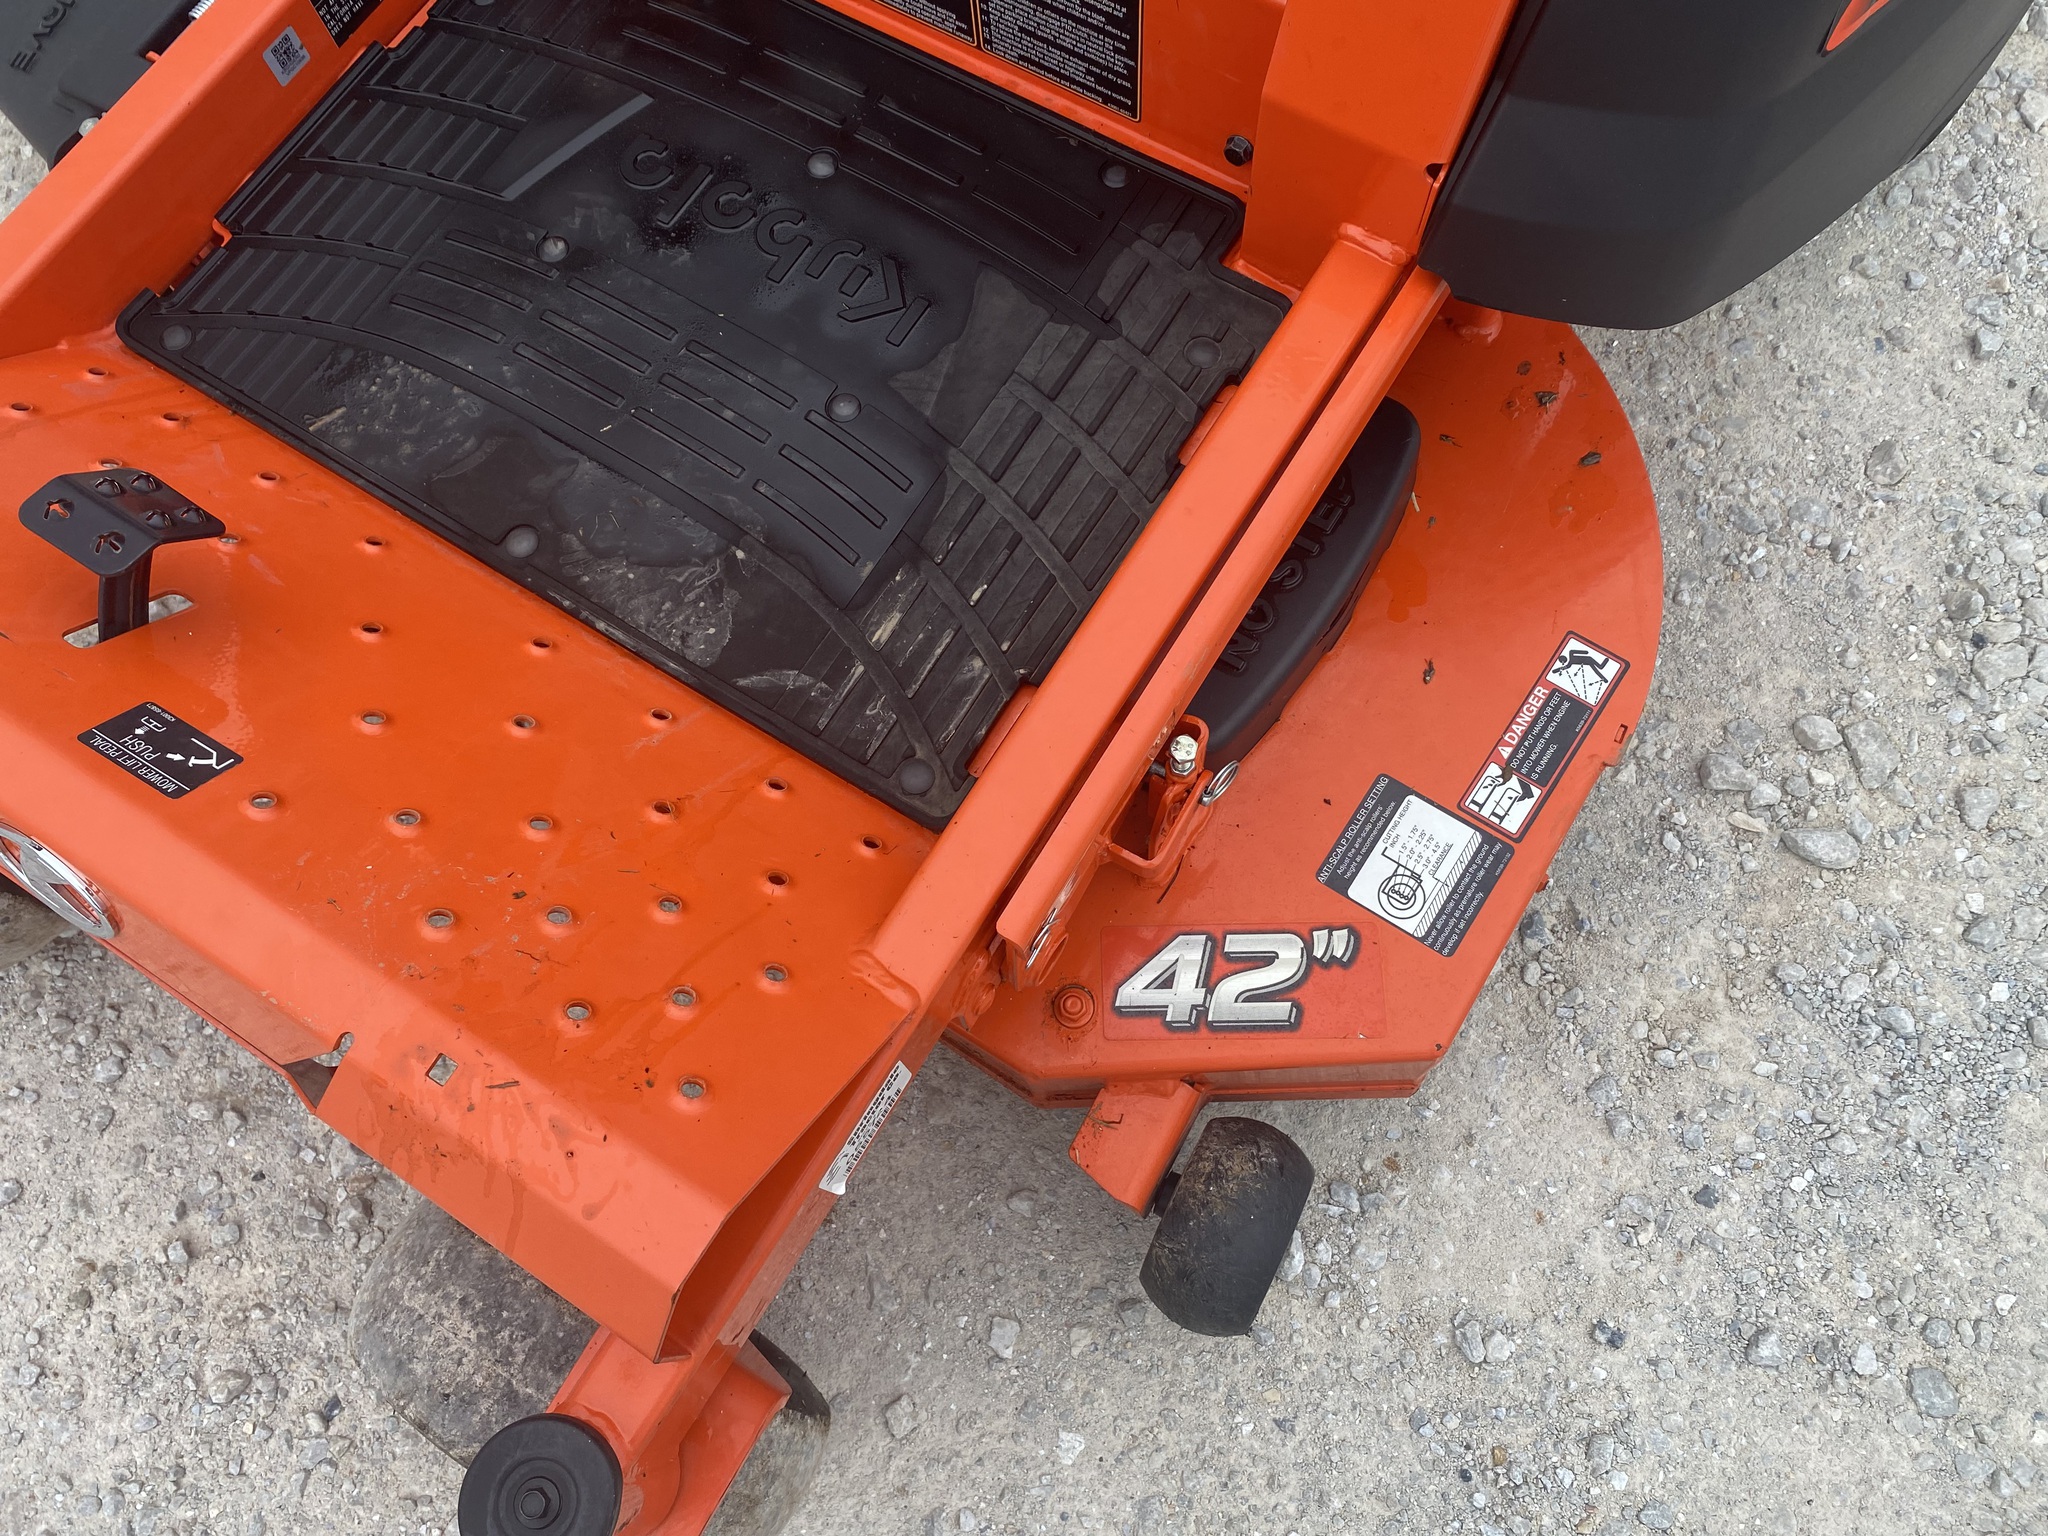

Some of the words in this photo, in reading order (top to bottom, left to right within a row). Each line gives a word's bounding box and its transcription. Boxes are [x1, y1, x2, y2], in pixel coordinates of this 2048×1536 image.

[322, 12, 331, 22] IN
[330, 2, 340, 14] THE
[326, 0, 354, 29] CALIFORNIA
[330, 21, 343, 36] DOES
[342, 10, 352, 23] NOT
[619, 133, 932, 348] Kubota
[1503, 684, 1549, 745] DANGER
[1509, 757, 1520, 768] DO
[1515, 745, 1528, 759] NOT
[1523, 733, 1535, 747] PUT
[1530, 714, 1547, 735] HANDS
[1542, 705, 1553, 716] OR
[1548, 691, 1562, 707] FEET
[1519, 758, 1533, 774] INTO
[1528, 737, 1547, 761] MOWER
[1542, 720, 1557, 739] WHEN
[1552, 699, 1571, 722] ENGINE
[90, 735, 119, 757] PEDAL
[117, 754, 142, 770] LIFT
[119, 735, 161, 760] PUSH
[1529, 771, 1539, 780] IS
[1534, 741, 1558, 773] RUNNING.
[137, 765, 179, 793] MOWER
[1317, 837, 1349, 883] ANTI-SCALP
[1344, 807, 1367, 839] ROLLER
[1363, 775, 1388, 809] SETTING
[1343, 861, 1358, 880] height
[1354, 854, 1362, 862] as
[1358, 816, 1386, 855] recommended
[1381, 799, 1396, 818] below.
[1381, 819, 1400, 844] CUTTING
[1396, 798, 1413, 820] HEIGHT
[1388, 833, 1401, 848] INCH
[1335, 856, 1351, 875] Adjust
[1346, 847, 1356, 858] the
[1352, 821, 1373, 849] anti-scalp
[1426, 841, 1452, 876] CLEARANCE
[1423, 927, 1438, 946] Never
[1433, 913, 1447, 929] allow
[1442, 899, 1455, 914] roller
[1451, 892, 1459, 900] to
[1455, 872, 1472, 894] contact
[1467, 862, 1477, 873] the
[1472, 843, 1490, 864] ground
[1431, 916, 1458, 952] continuously
[1453, 909, 1461, 917] as
[1457, 881, 1479, 910] premature
[1473, 867, 1486, 882] roller
[1482, 853, 1495, 868] wear
[1491, 841, 1503, 855] may
[1439, 932, 1459, 956] develop
[1456, 918, 1466, 929] set
[1461, 889, 1485, 920] incorrectly.
[1115, 927, 1359, 1030] 42"
